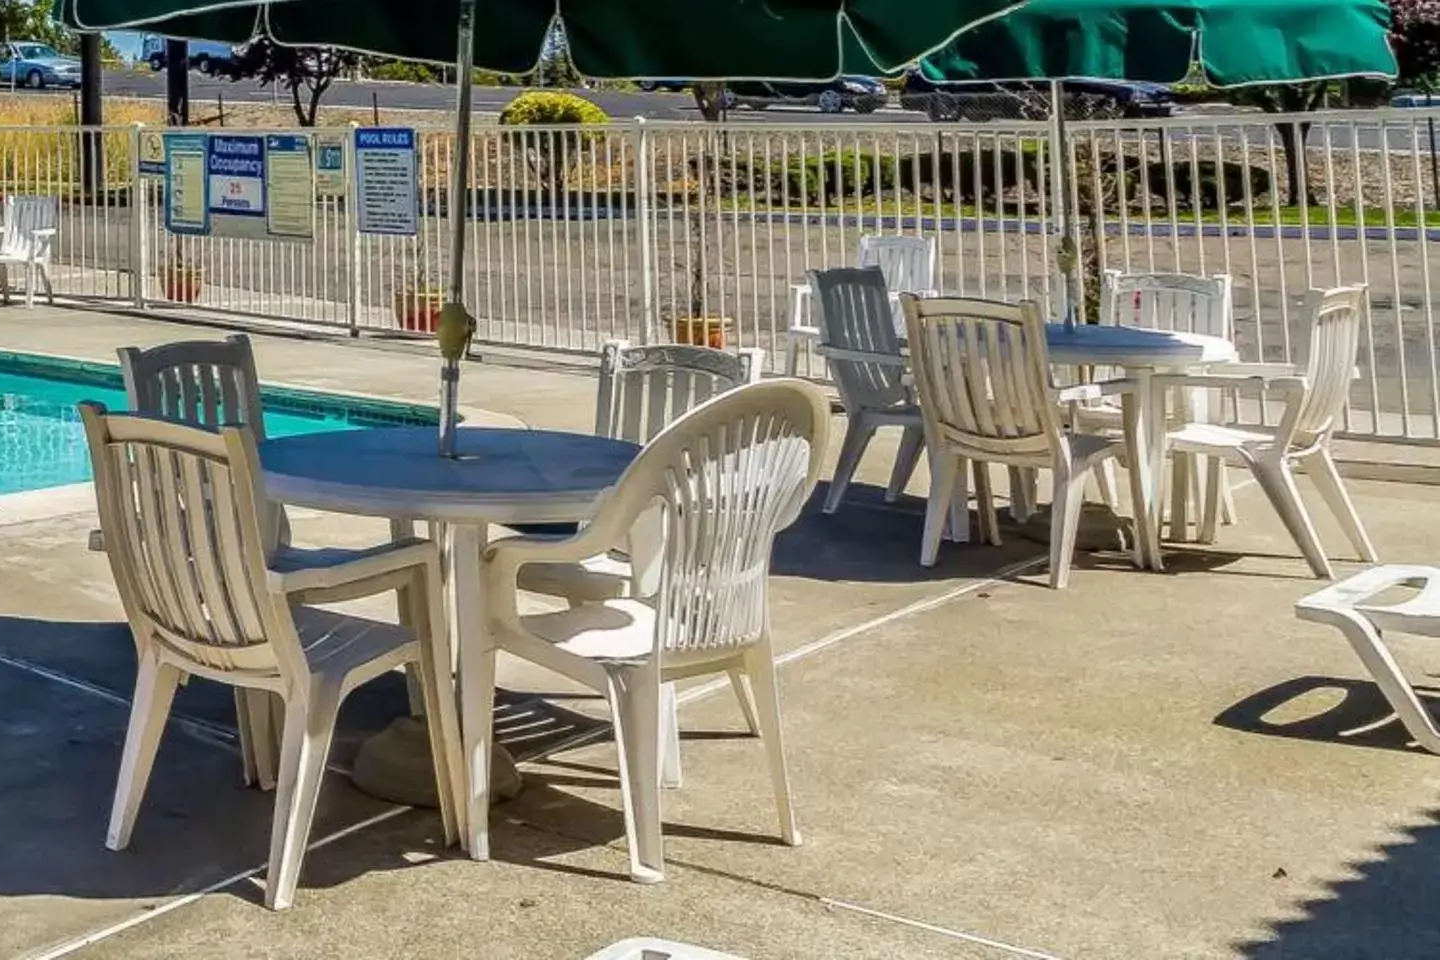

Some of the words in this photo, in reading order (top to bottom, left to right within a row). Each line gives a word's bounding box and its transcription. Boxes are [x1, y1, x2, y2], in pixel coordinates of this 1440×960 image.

[214, 137, 259, 156] Maximum
[360, 132, 380, 145] POOL
[382, 132, 408, 145] RULES
[210, 154, 262, 177] Occupancy
